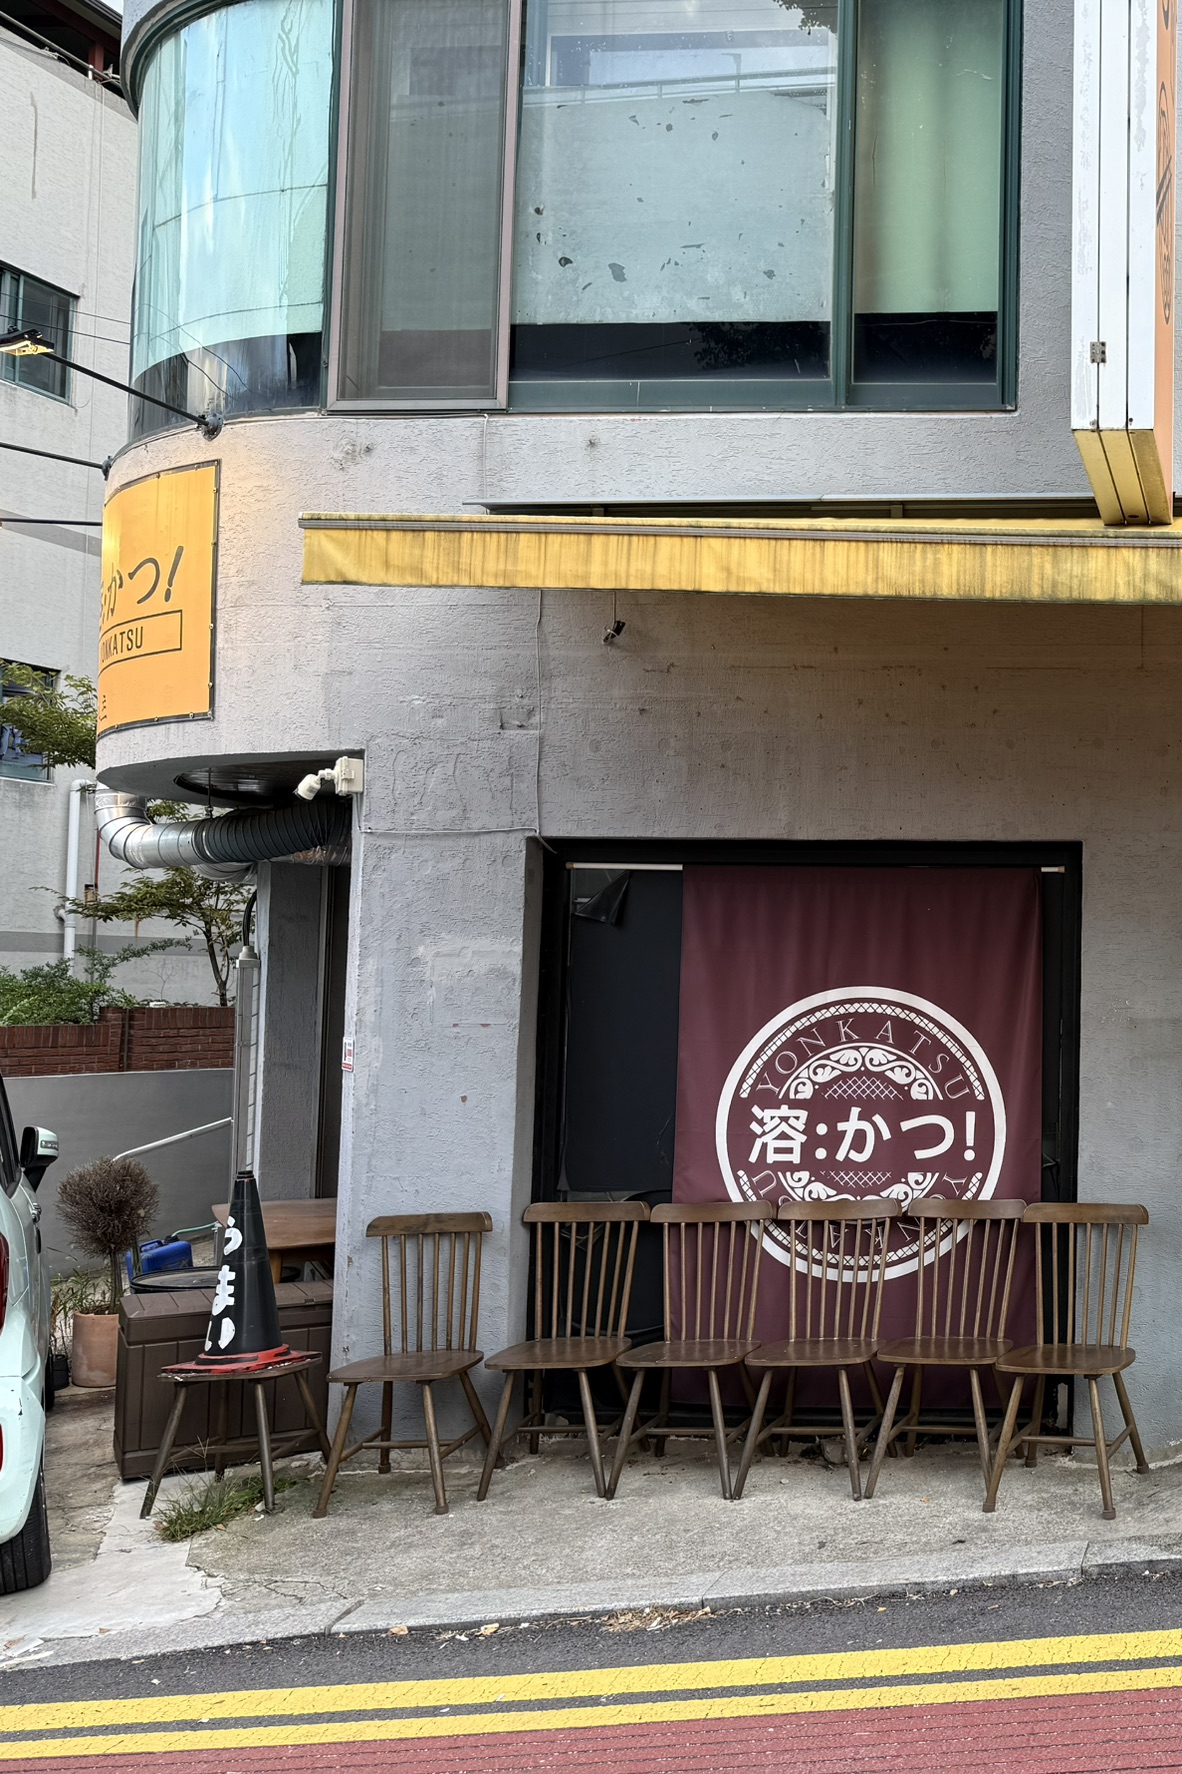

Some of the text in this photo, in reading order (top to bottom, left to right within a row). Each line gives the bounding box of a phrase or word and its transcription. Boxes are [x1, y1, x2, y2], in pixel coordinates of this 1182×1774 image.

[756, 1018, 972, 1100] YONKATSU
[747, 1104, 977, 1166] 溶:かつ!
[204, 1215, 243, 1352] うまい
